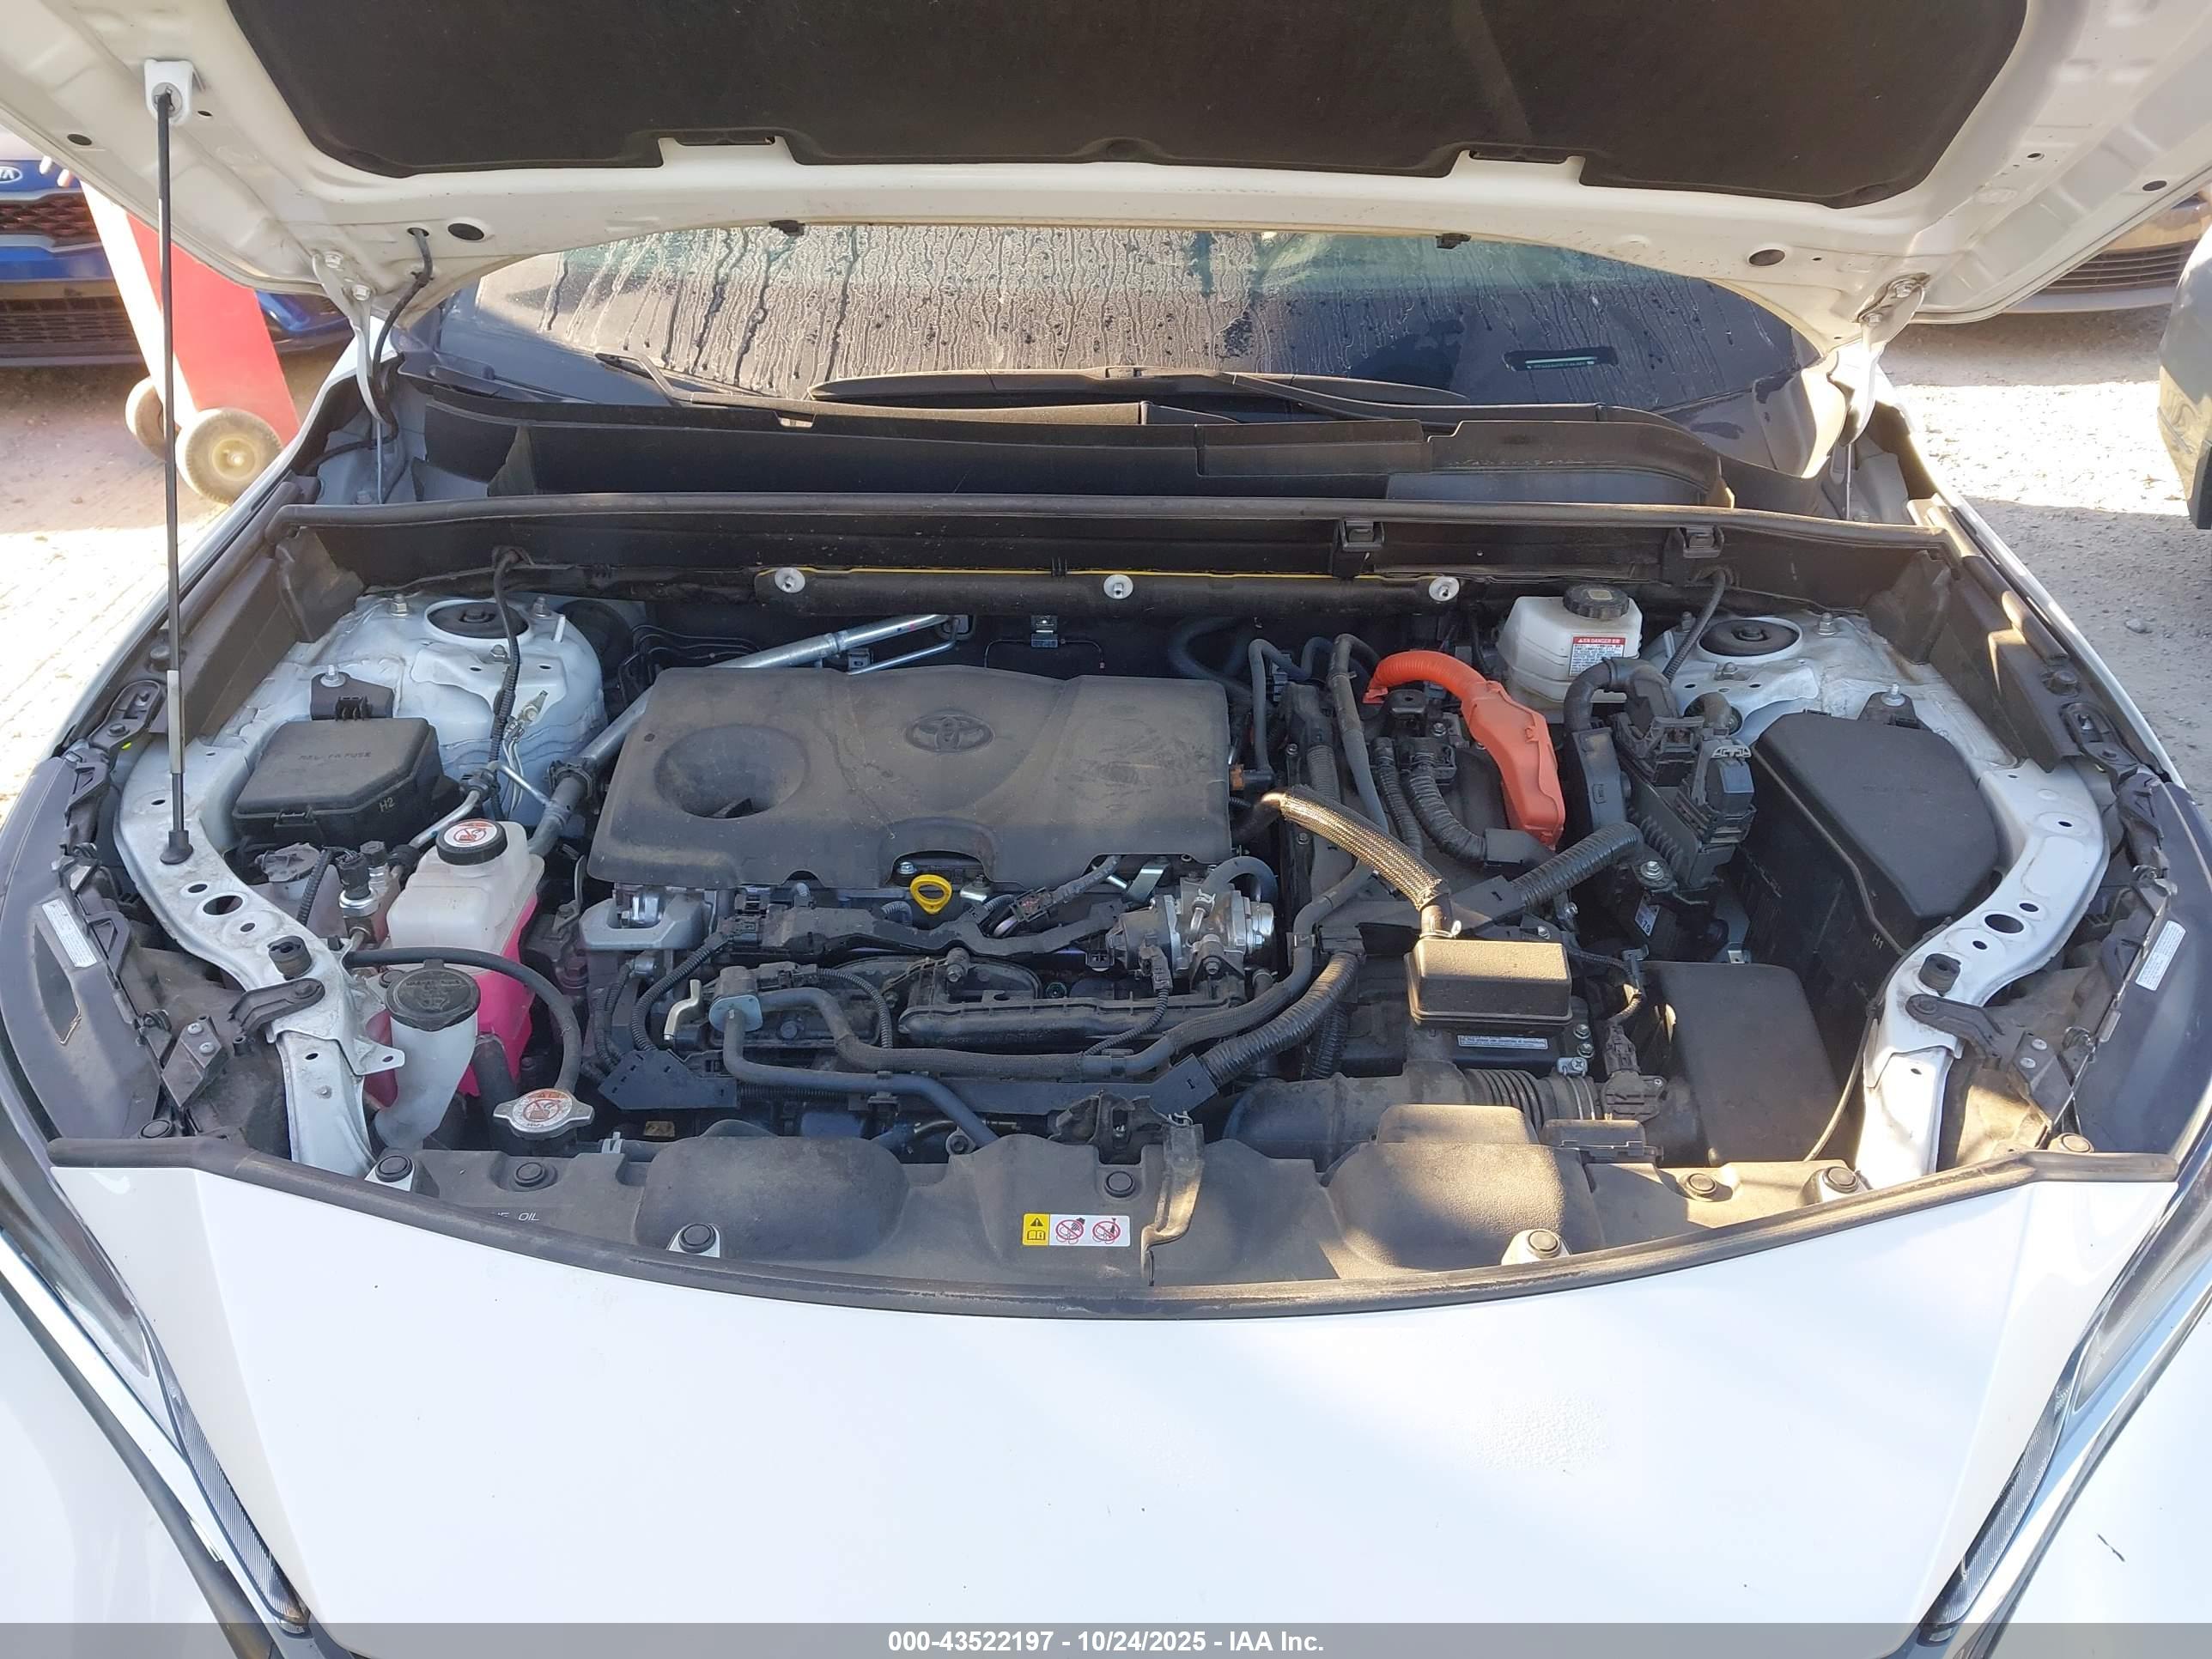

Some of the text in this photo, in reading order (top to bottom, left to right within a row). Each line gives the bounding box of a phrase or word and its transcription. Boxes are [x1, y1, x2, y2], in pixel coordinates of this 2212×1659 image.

[379, 796, 395, 812] H2
[1872, 933, 1884, 949] H1
[518, 1212, 540, 1221] OIL
